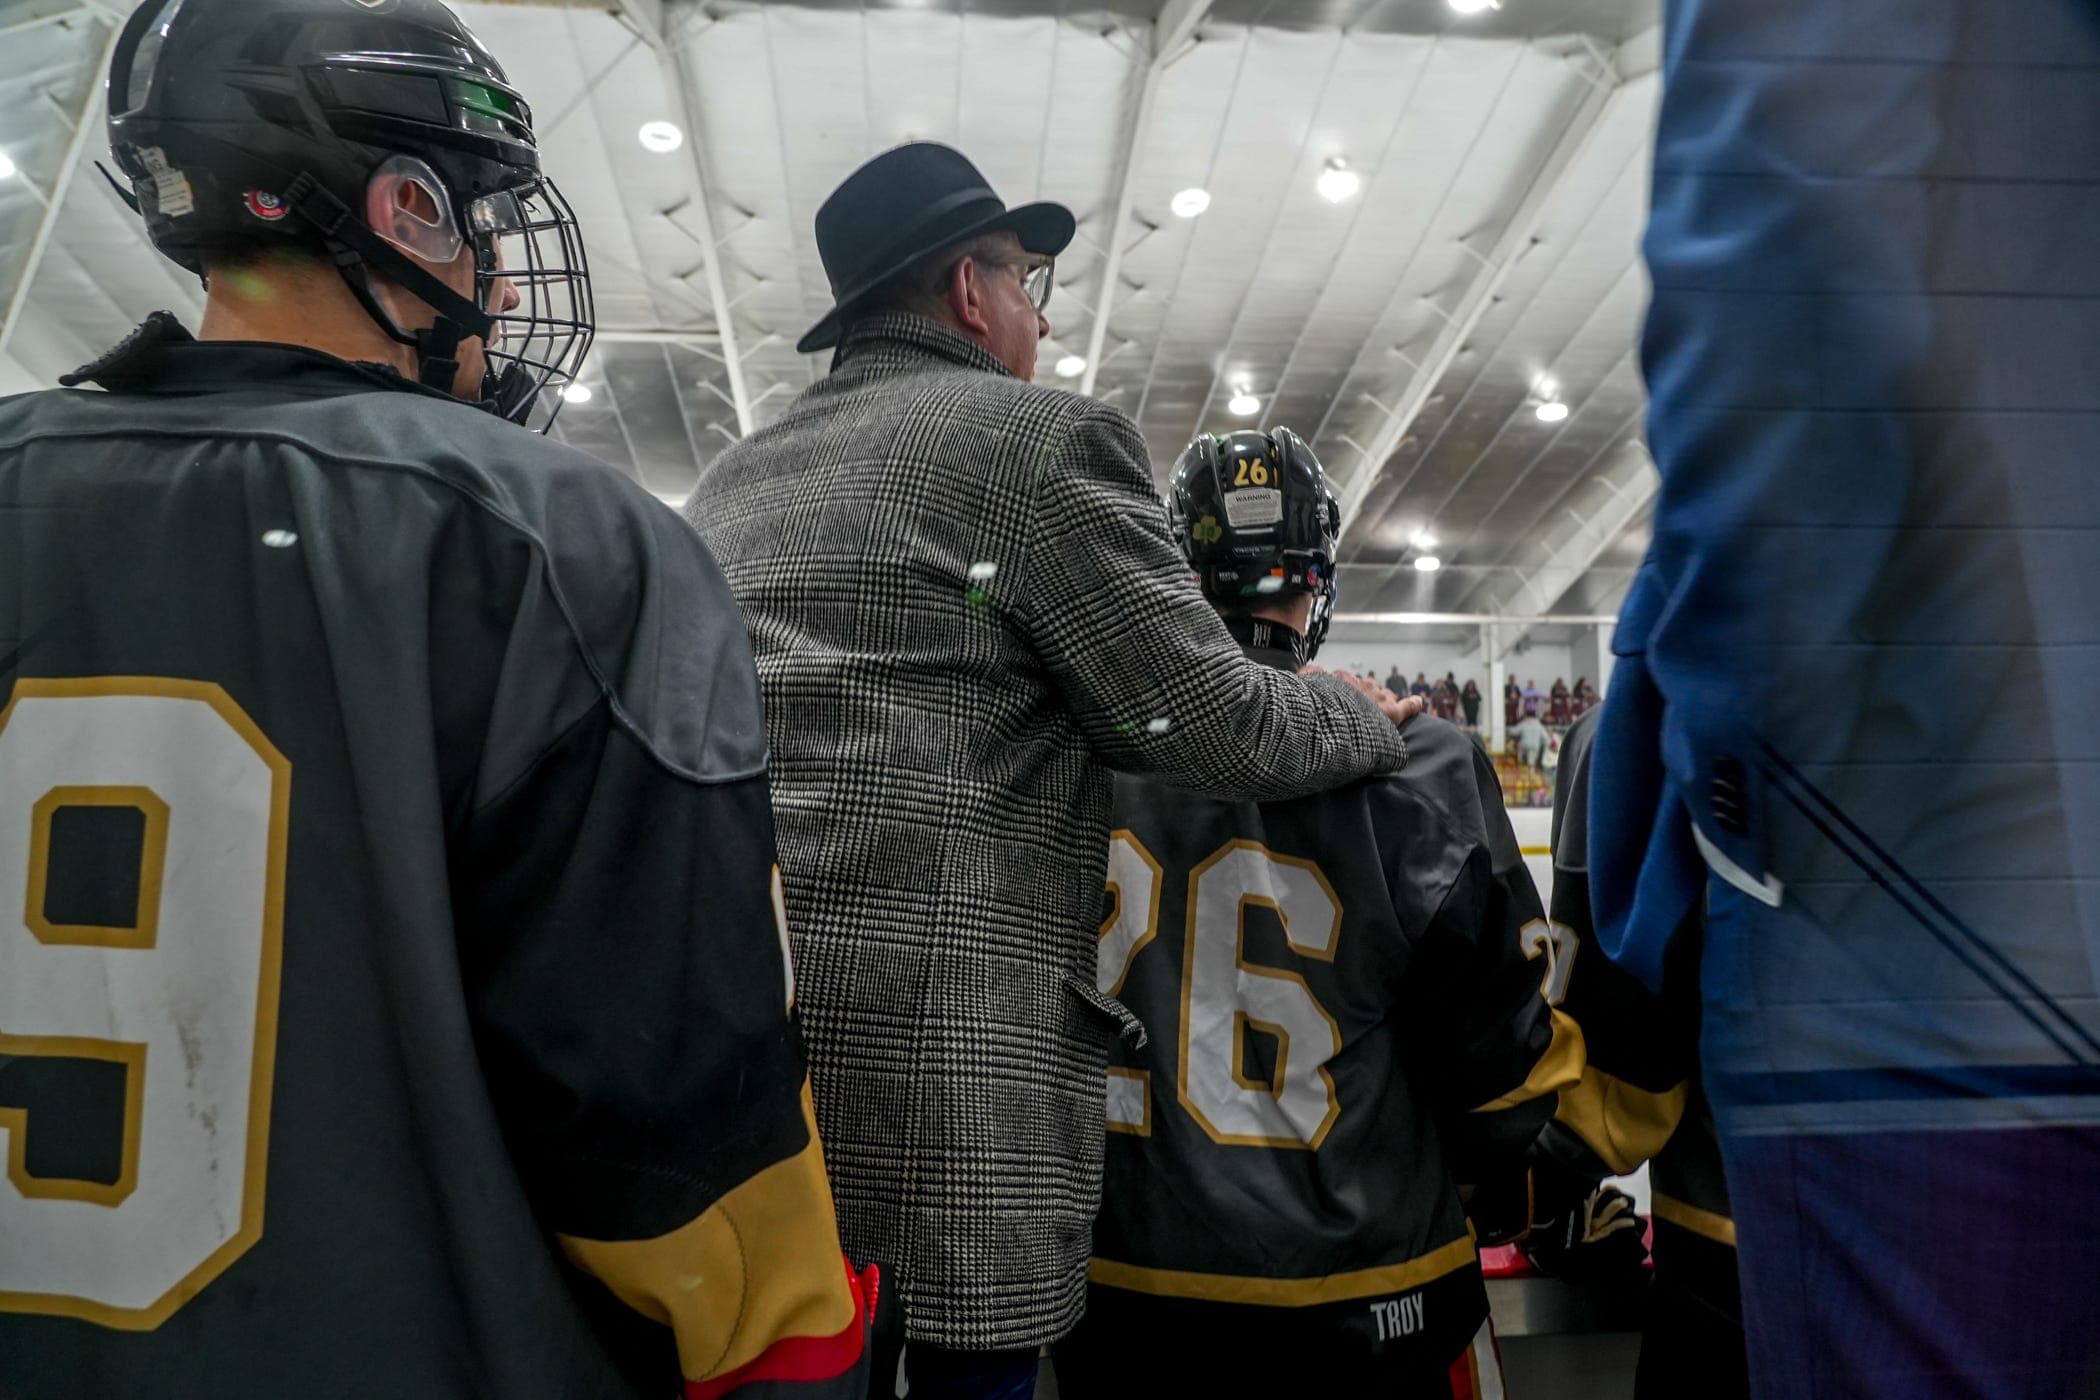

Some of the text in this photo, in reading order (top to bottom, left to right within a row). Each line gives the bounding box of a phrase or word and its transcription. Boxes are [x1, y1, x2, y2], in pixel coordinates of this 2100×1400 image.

[1234, 457, 1268, 487] 26
[0, 675, 292, 1333] 9
[1370, 1291, 1424, 1341] TROY
